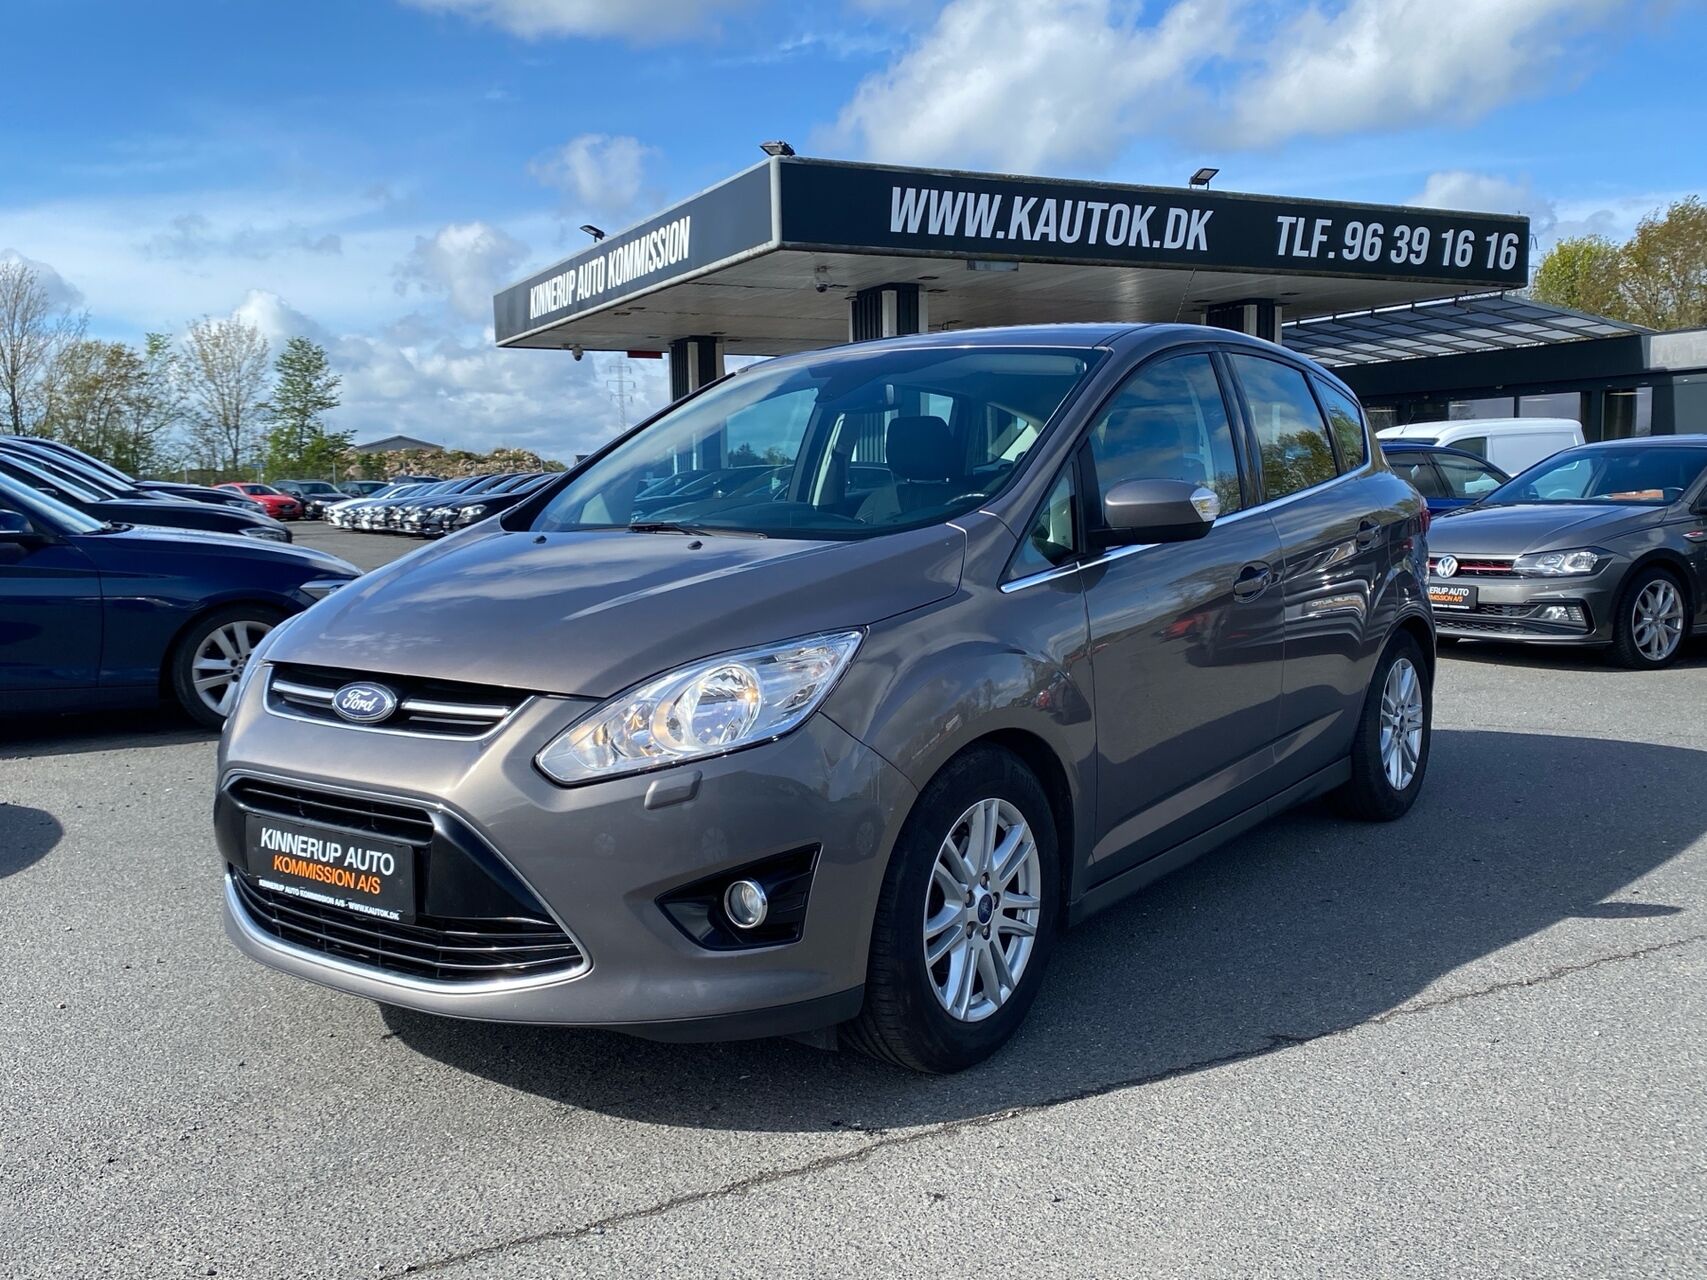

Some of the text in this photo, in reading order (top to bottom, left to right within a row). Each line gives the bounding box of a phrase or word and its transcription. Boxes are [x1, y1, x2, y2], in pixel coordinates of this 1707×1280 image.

[890, 187, 1214, 251] WWW.KAUTOK.DK
[1276, 215, 1520, 271] TLF. 96 39 16 16
[530, 215, 691, 320] KINNERUP AUTO KOMMISSION
[1430, 586, 1469, 597] ERUP AUTO
[342, 689, 379, 712] Ford
[260, 827, 395, 876] KINNERUP AUTO
[273, 854, 381, 895] KOMMISSION A/S
